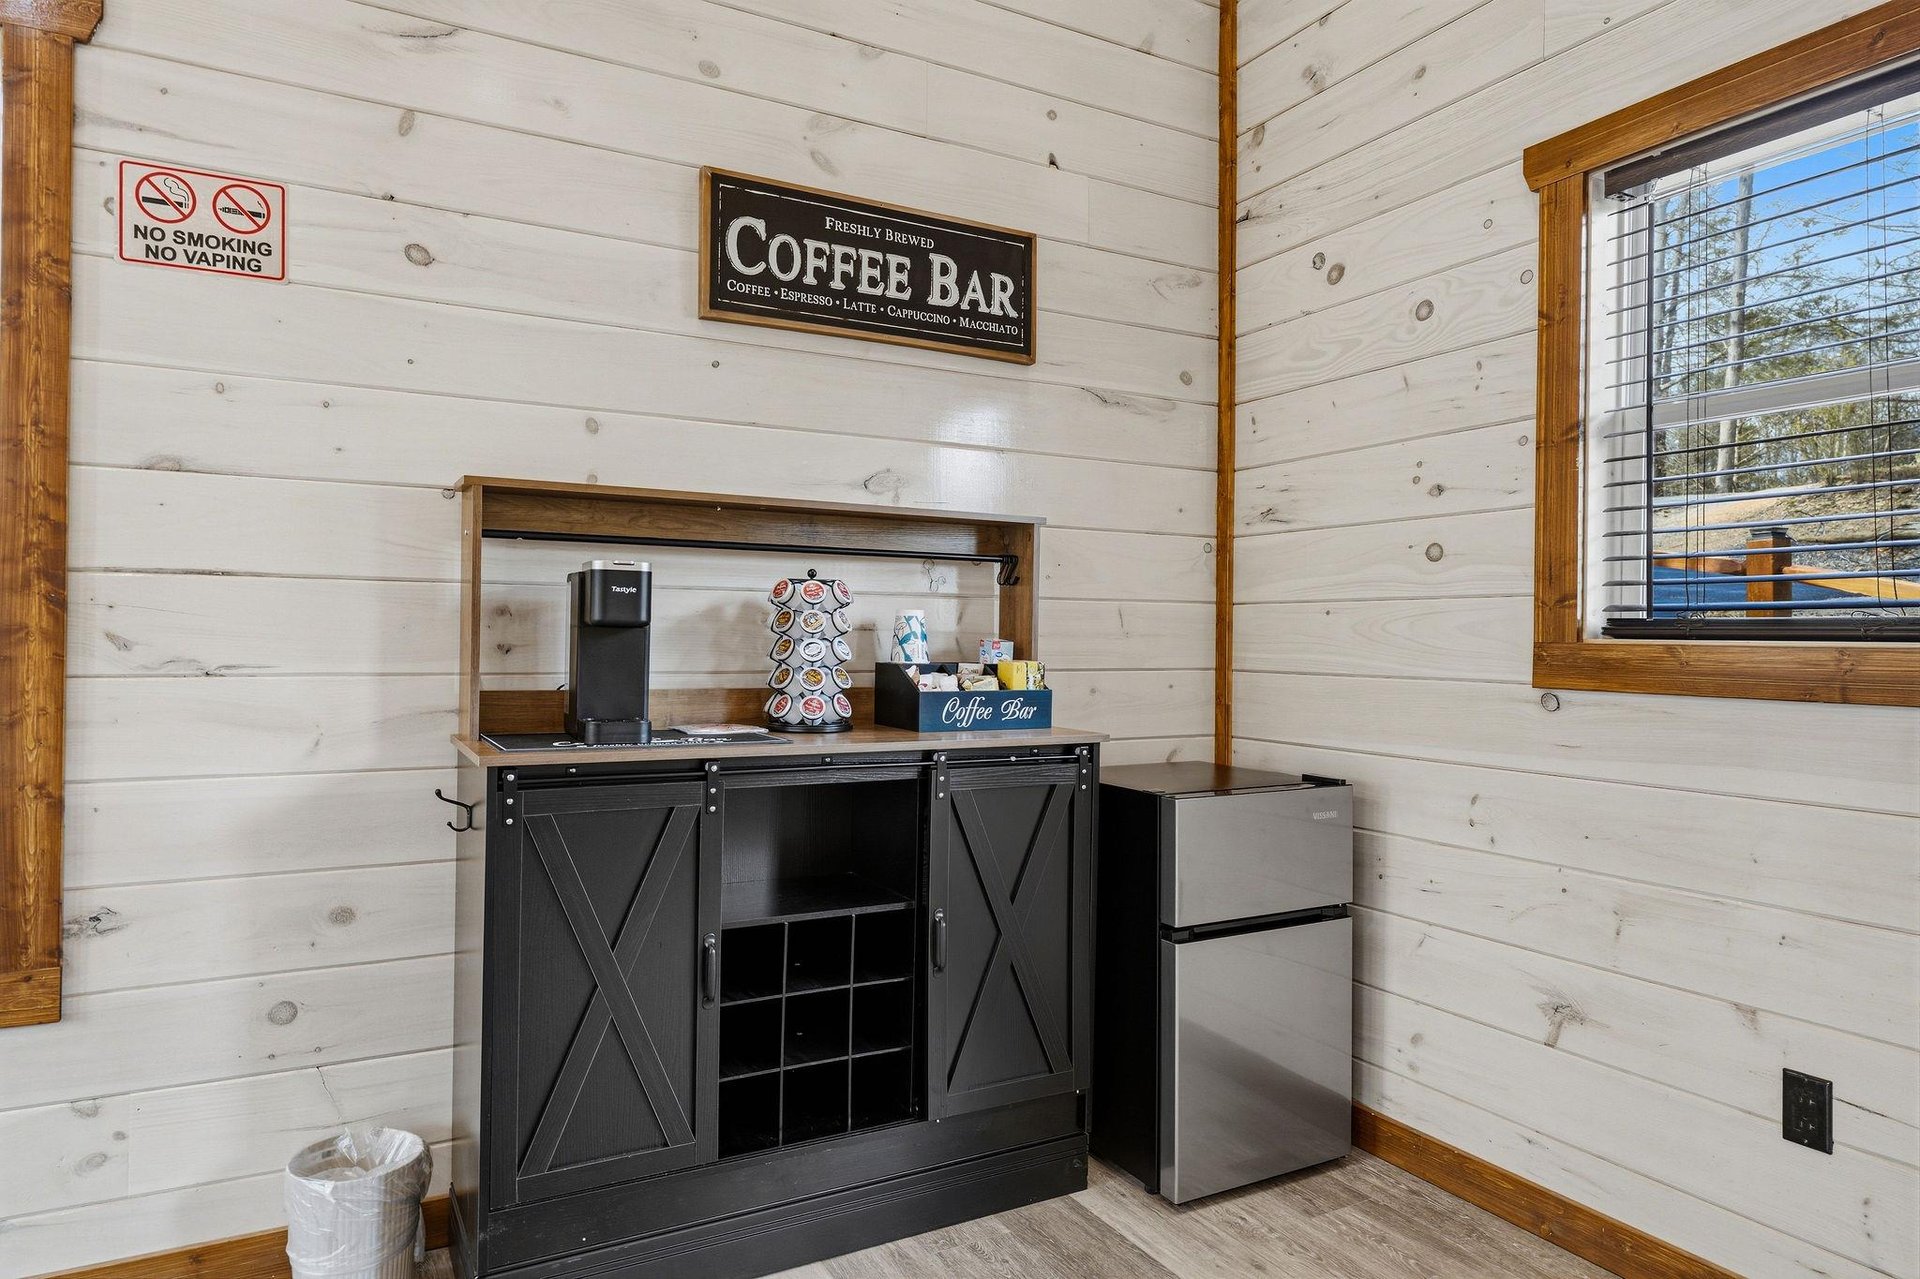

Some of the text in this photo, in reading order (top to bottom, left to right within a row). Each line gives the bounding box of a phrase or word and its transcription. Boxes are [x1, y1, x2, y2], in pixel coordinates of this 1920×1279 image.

[133, 224, 273, 257] NO SMOKING
[824, 216, 935, 249] FRESHLY BREWED
[145, 243, 262, 273] NO VAPING
[725, 215, 1019, 318] COFFEE BAR
[727, 279, 1019, 336] COFFEE ESPRESSO LATTE CAPPUCCINO MACCHIATO
[942, 696, 1037, 728] Coffee Bar
